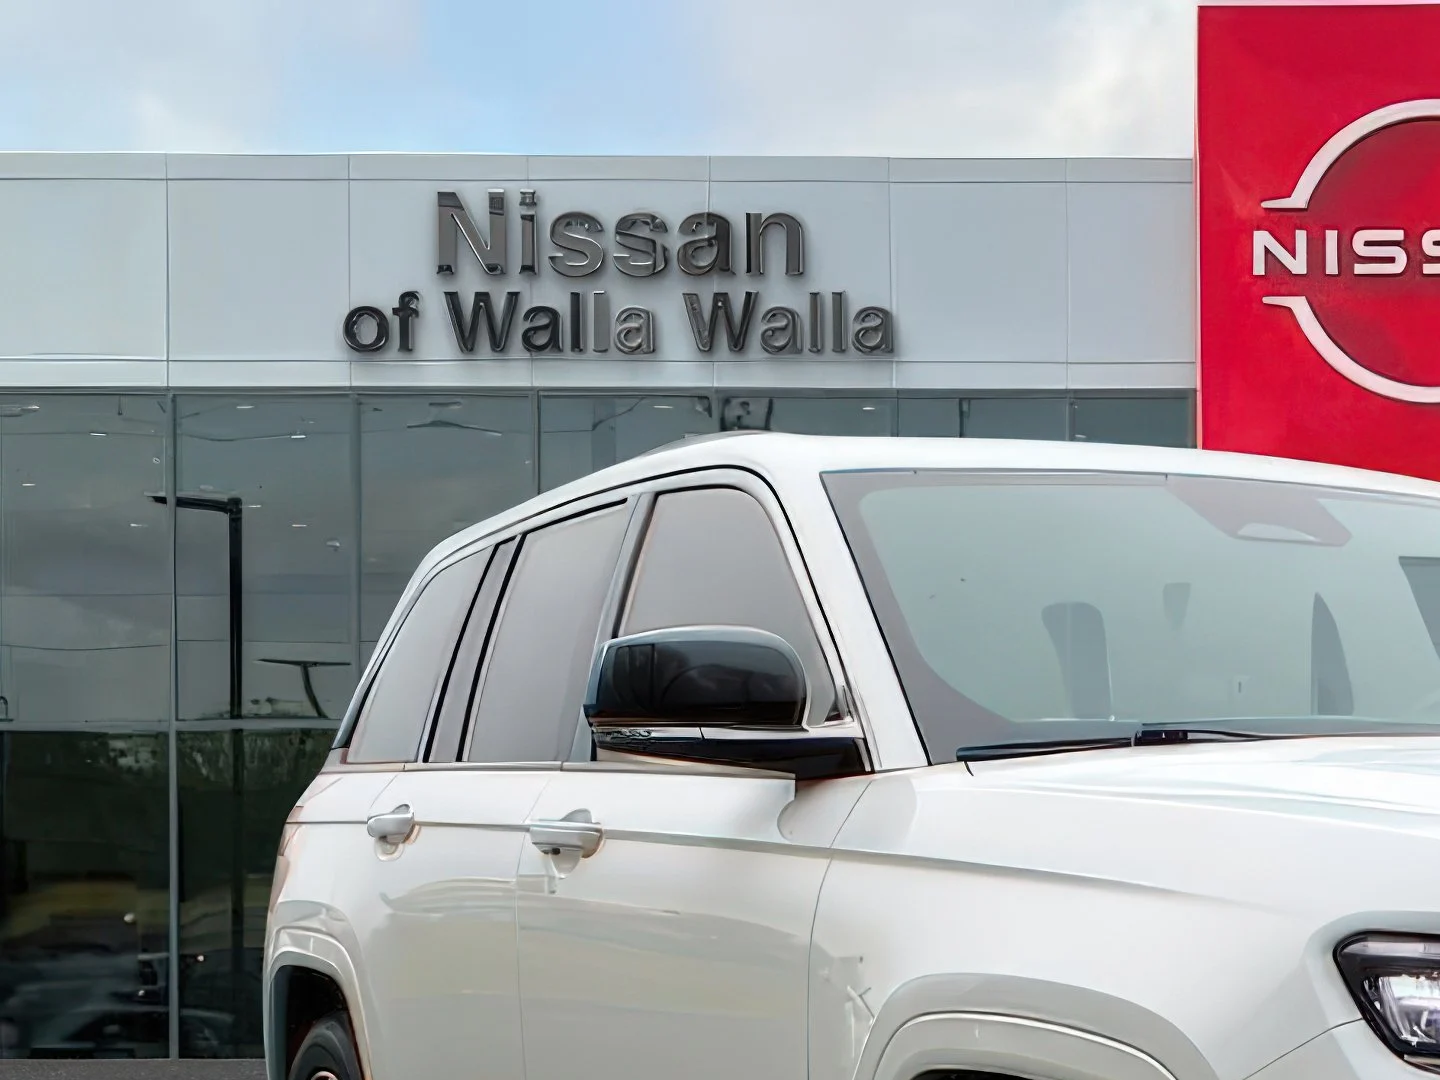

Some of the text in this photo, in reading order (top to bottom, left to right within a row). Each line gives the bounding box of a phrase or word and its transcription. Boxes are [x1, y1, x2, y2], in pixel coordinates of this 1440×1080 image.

[436, 187, 805, 277] Nissan
[342, 290, 895, 354] of Walla Walla
